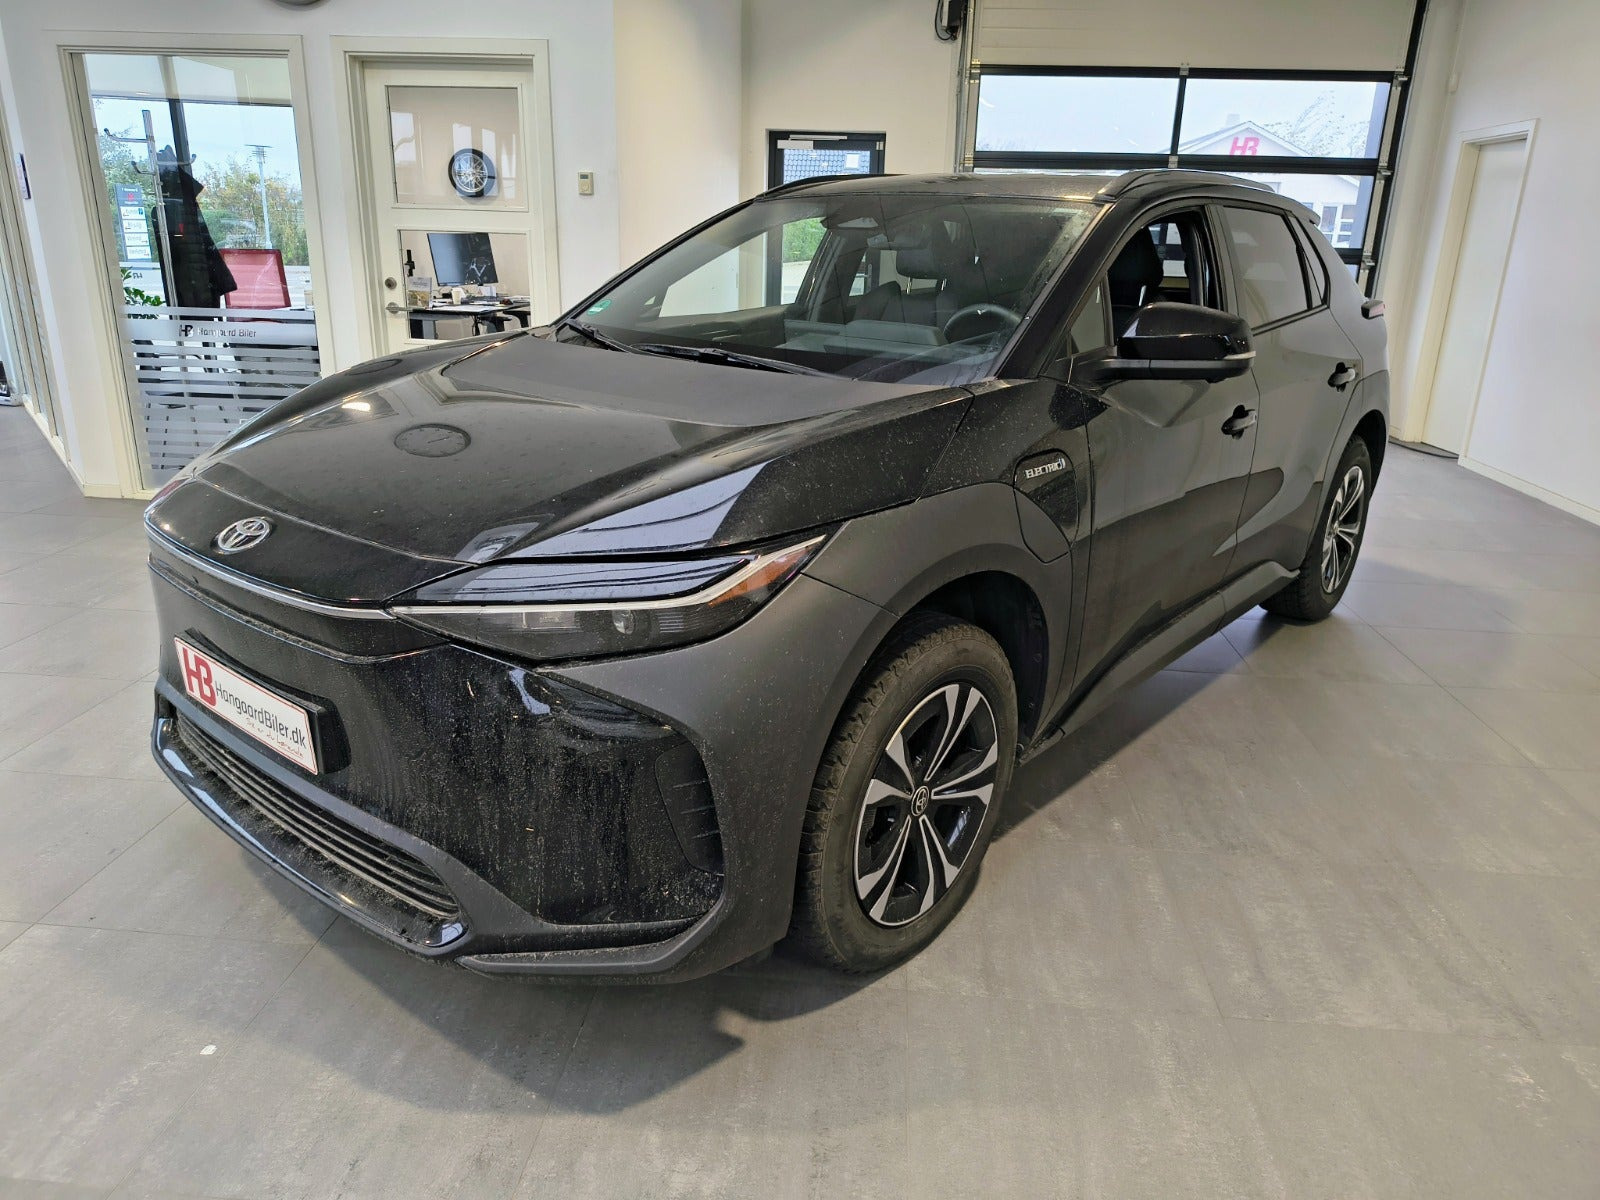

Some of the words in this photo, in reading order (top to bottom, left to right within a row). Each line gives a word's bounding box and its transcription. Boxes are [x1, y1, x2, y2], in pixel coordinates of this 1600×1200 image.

[1025, 461, 1062, 479] ELECTRIC
[182, 647, 217, 707] HB
[215, 681, 307, 749] HangaardBiler.dk
